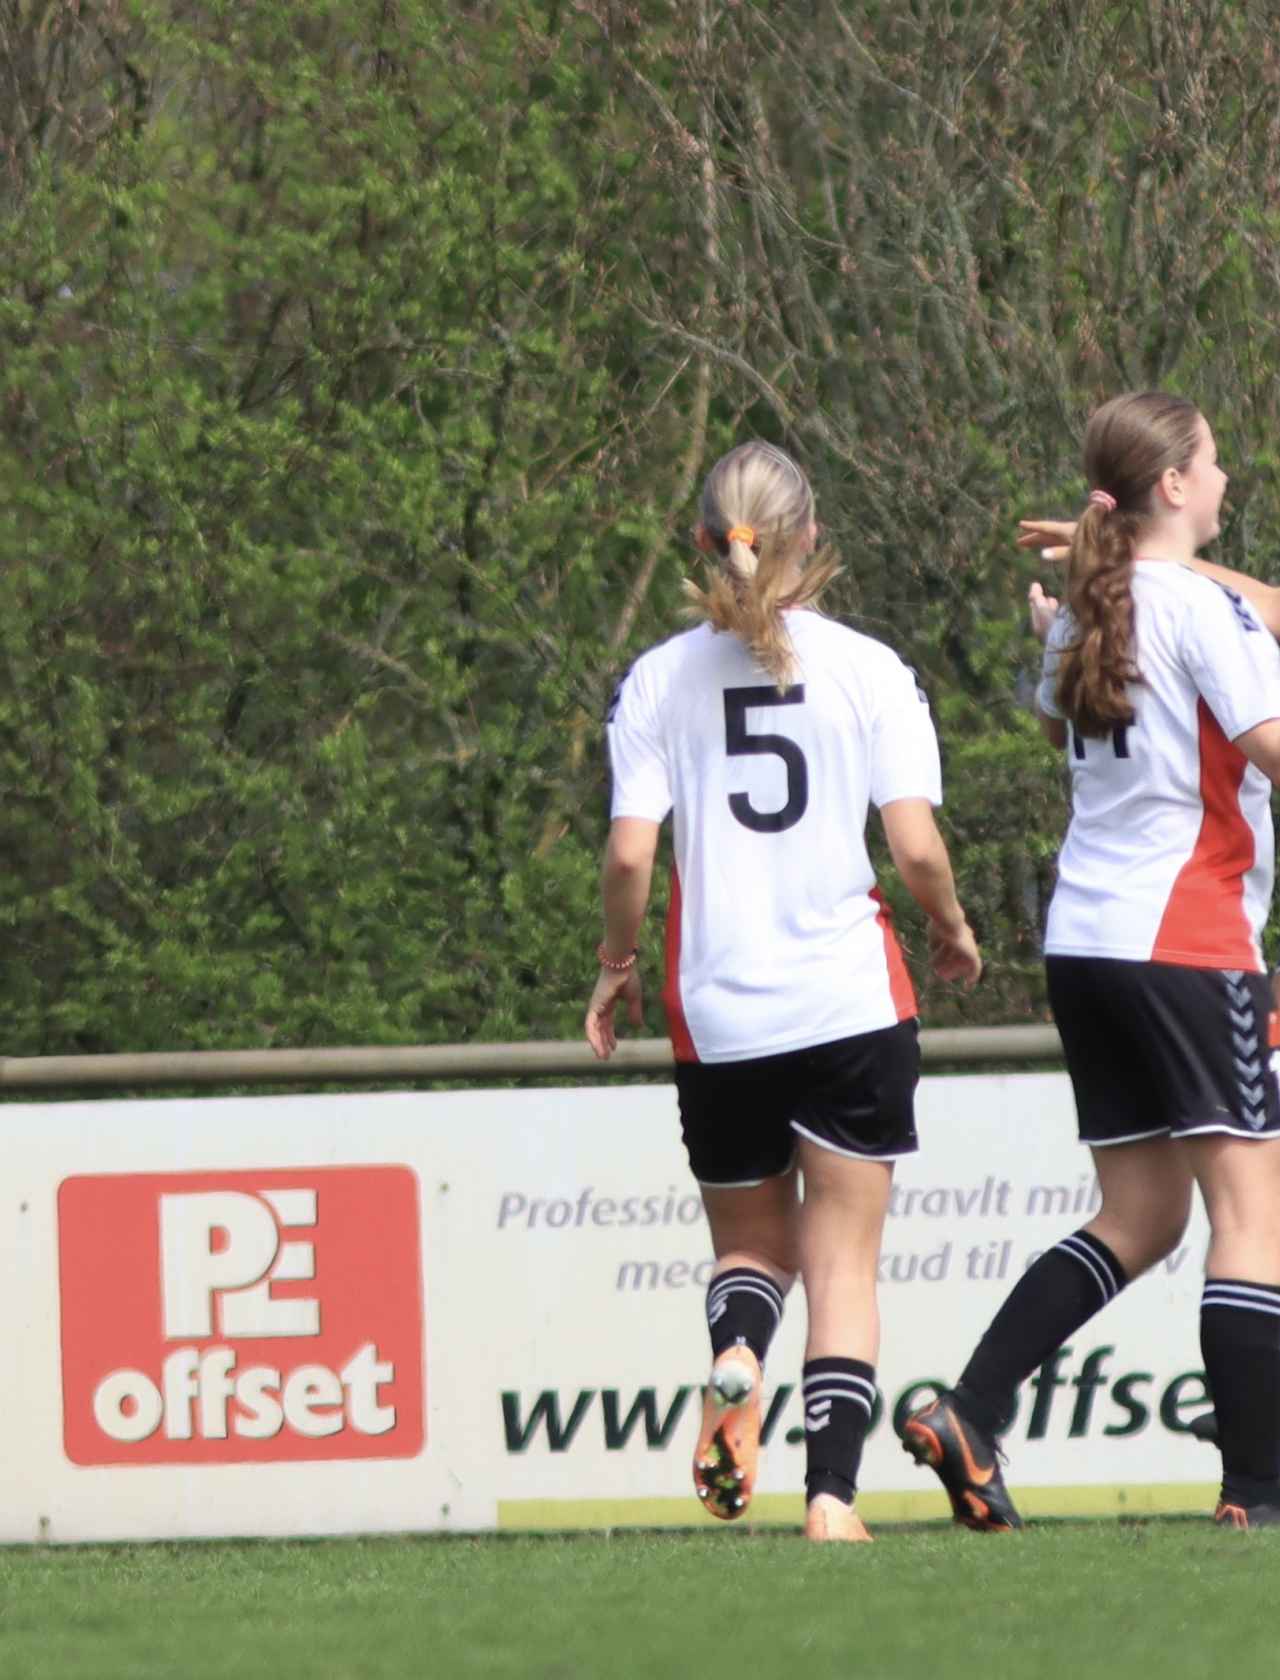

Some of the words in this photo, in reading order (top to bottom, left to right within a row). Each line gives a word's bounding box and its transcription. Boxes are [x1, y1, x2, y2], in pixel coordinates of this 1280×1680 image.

[723, 684, 809, 833] 5
[496, 1185, 708, 1231] Professio
[1026, 1174, 1102, 1216] mil
[158, 1188, 320, 1341] PE
[965, 1238, 1013, 1280] til
[93, 1341, 397, 1441] offset
